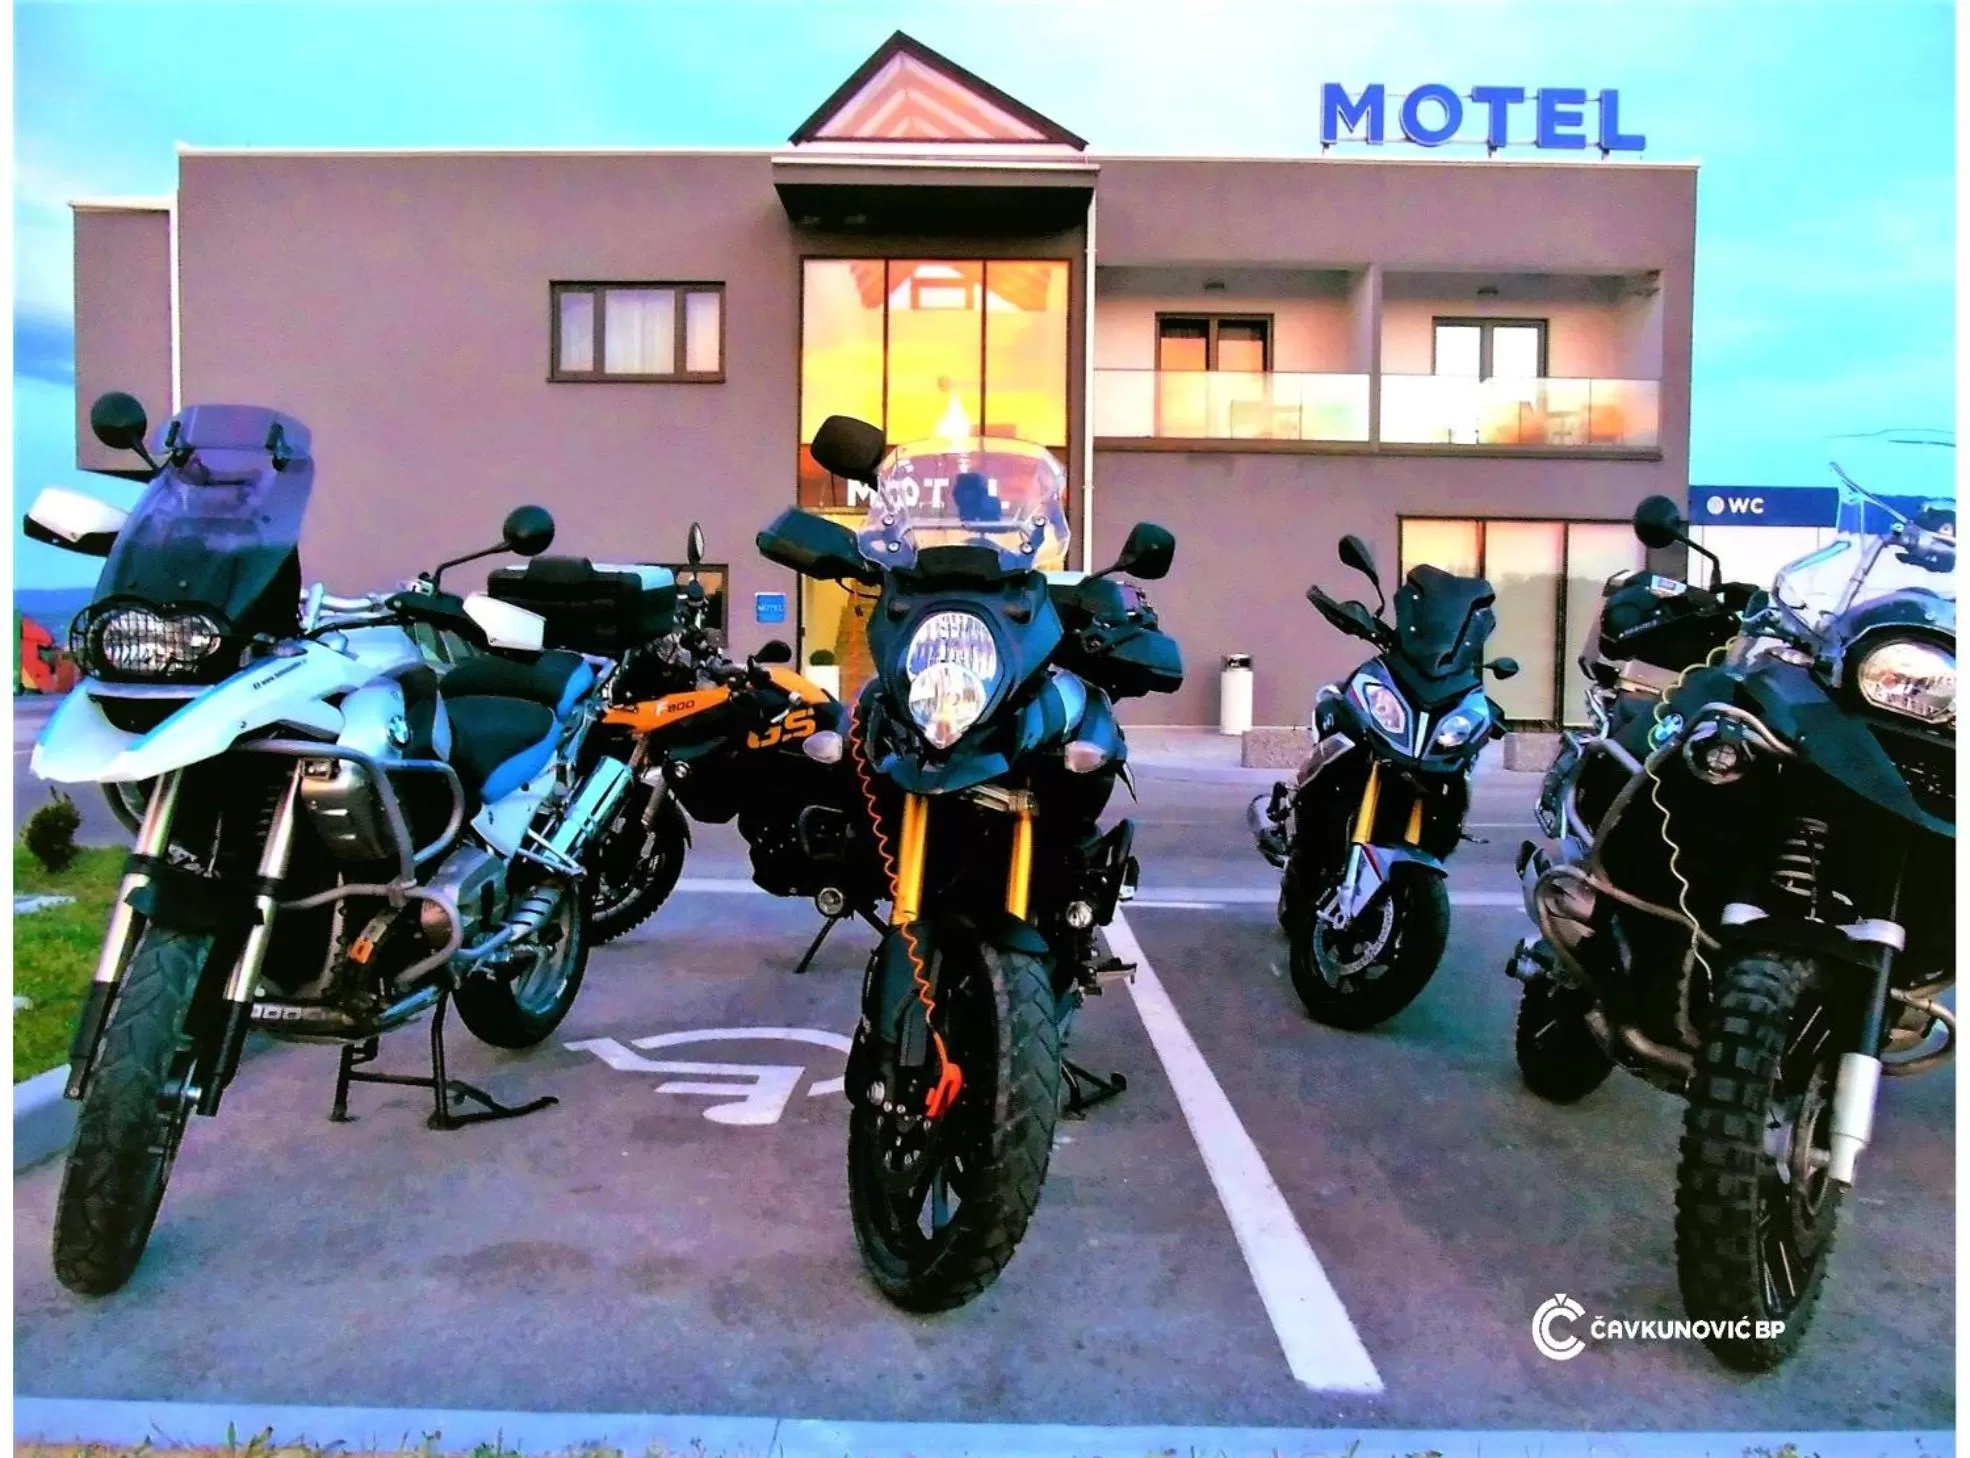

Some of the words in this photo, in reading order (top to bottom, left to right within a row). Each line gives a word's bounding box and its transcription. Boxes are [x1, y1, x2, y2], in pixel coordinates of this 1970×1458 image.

[1320, 83, 1646, 151] MOTEL
[847, 476, 1009, 508] MOTL
[1728, 498, 1764, 514] WC
[656, 700, 695, 716] F800
